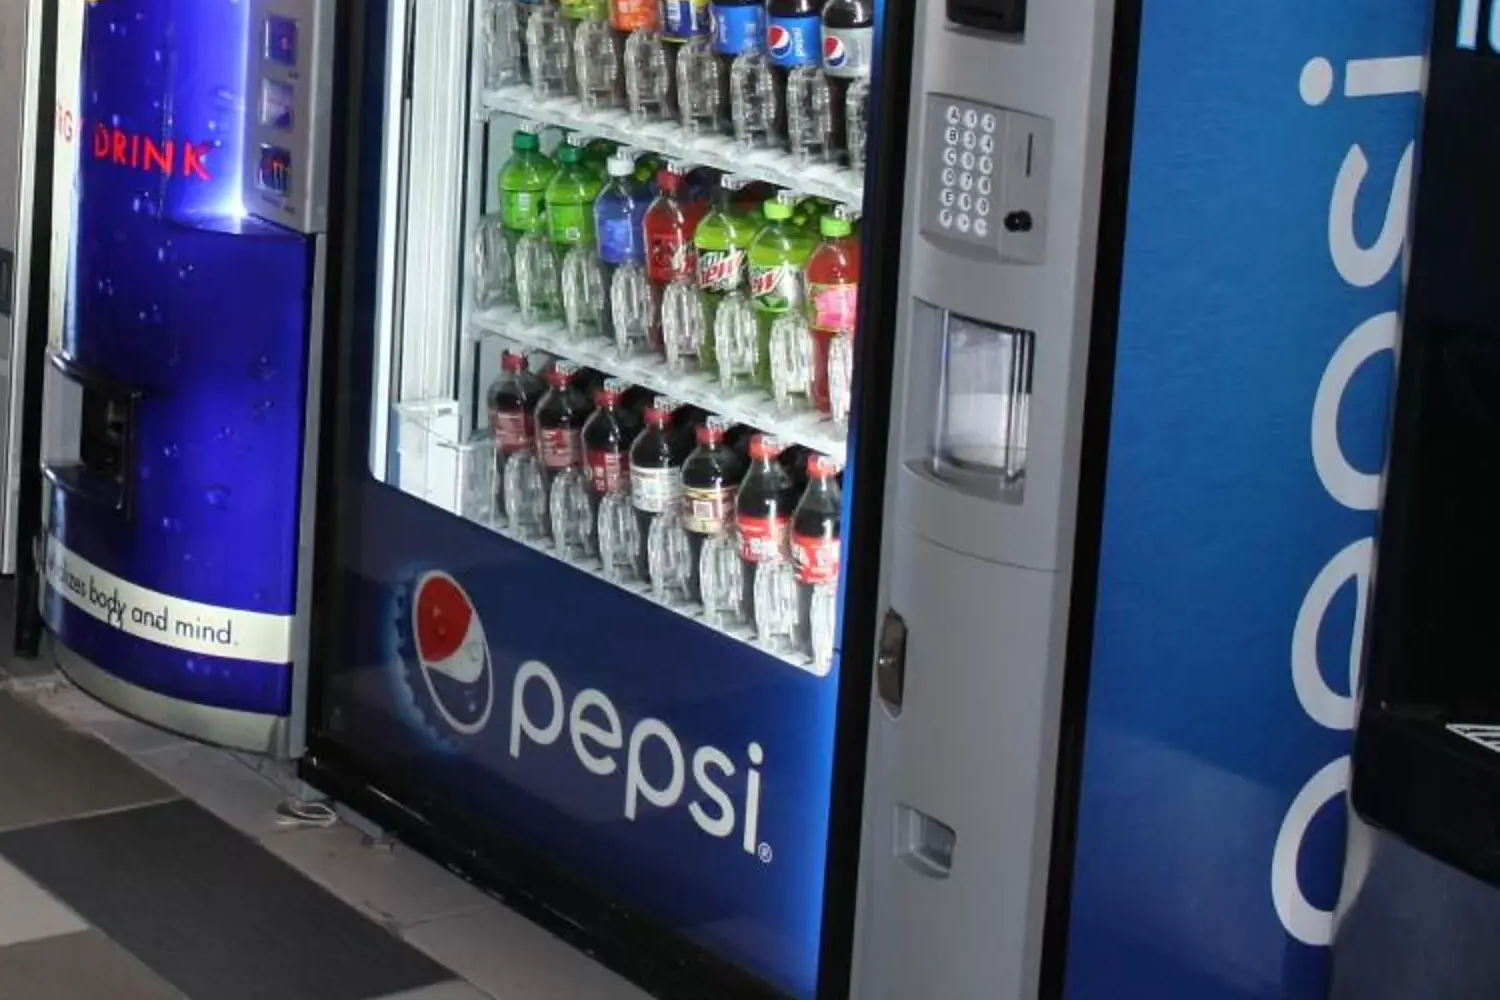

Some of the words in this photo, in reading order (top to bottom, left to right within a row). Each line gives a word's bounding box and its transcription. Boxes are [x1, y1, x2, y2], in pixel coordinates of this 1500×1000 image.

[94, 124, 213, 182] DRINK
[89, 572, 127, 630] body
[131, 604, 169, 632] and
[509, 659, 764, 855] pepsi
